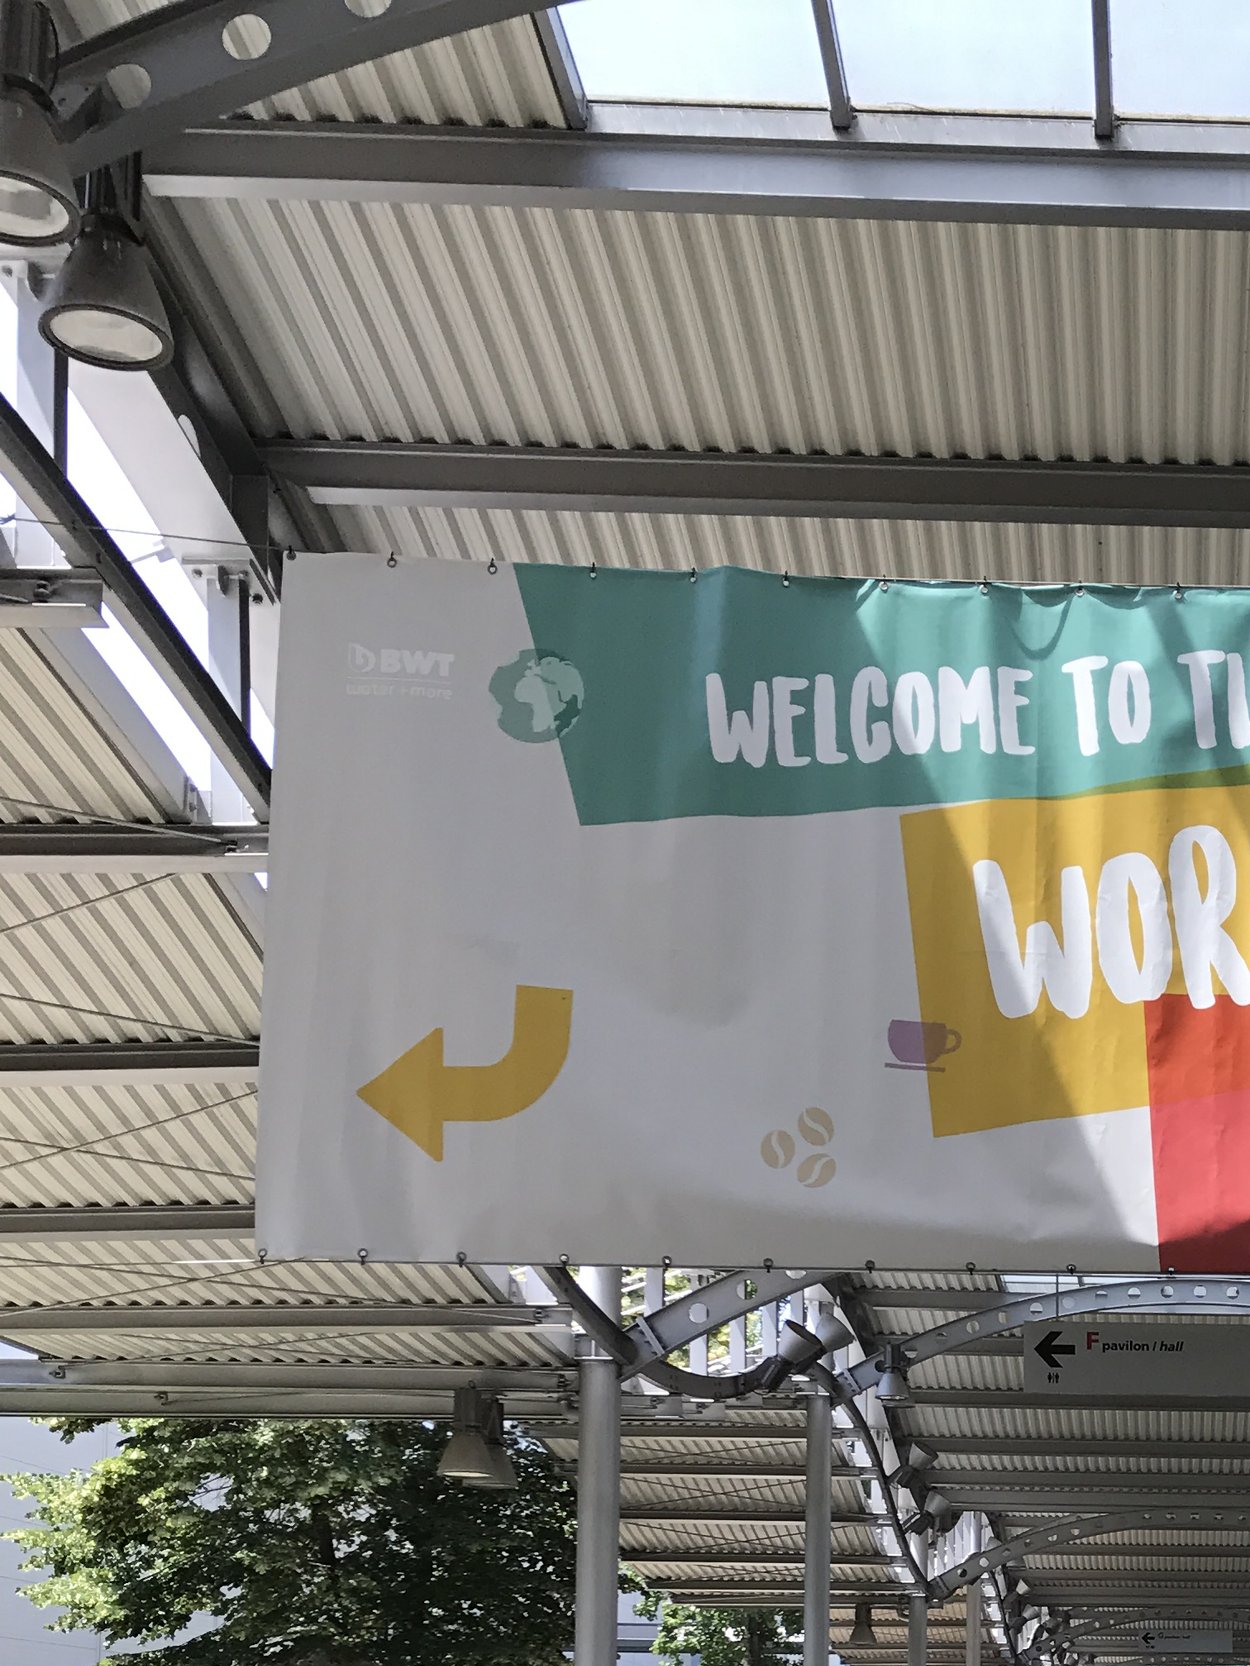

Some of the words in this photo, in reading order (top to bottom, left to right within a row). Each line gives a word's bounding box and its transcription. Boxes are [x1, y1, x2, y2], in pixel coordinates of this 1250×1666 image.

[380, 648, 455, 677] BWT
[705, 666, 1036, 768] WELCOME
[1061, 655, 1152, 756] TO
[1086, 1331, 1100, 1351] F
[1101, 1340, 1150, 1353] pavilon
[1159, 1340, 1185, 1352] hall
